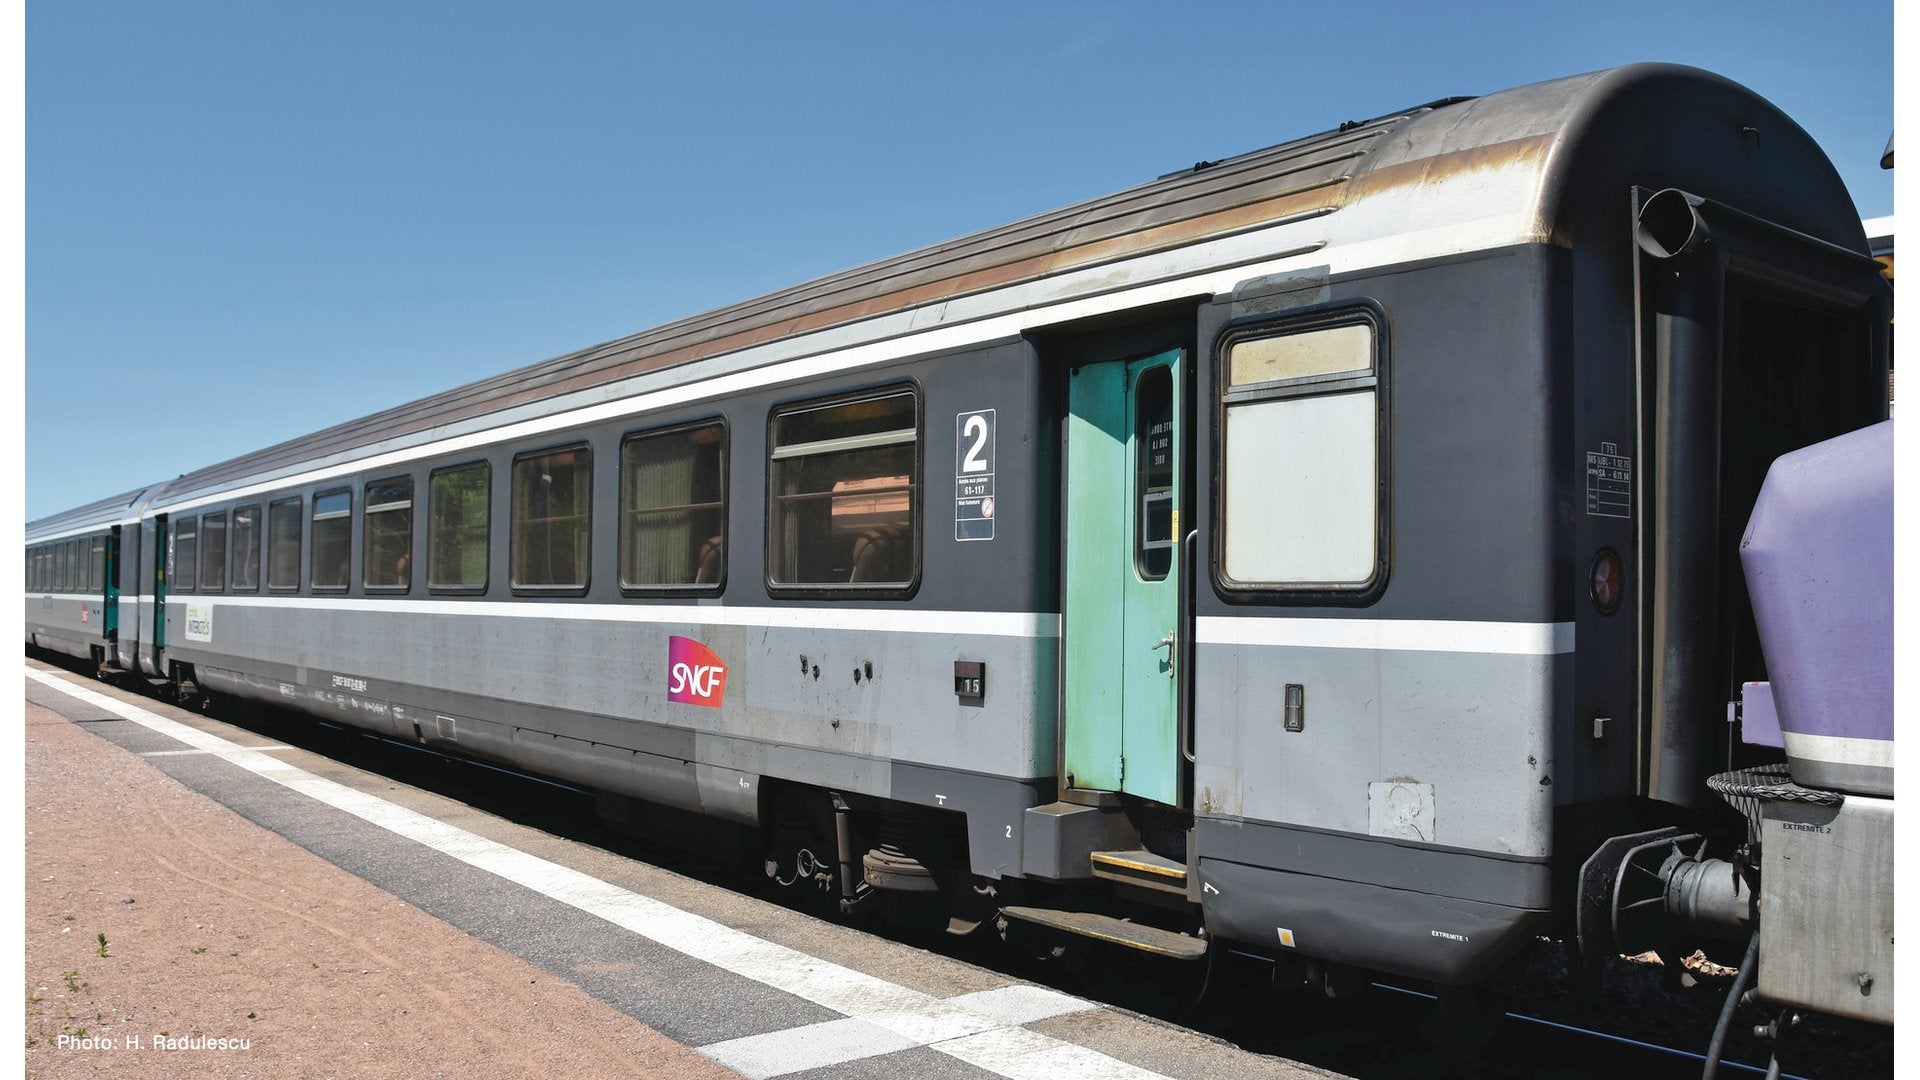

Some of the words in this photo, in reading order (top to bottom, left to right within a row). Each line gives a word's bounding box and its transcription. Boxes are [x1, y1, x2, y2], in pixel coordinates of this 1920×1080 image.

[963, 415, 988, 472] 2
[965, 485, 985, 495] 61-117
[670, 662, 724, 698] SNCF
[965, 679, 979, 693] 15
[1005, 825, 1011, 838] 2
[1782, 823, 1824, 833] EXTREMITE
